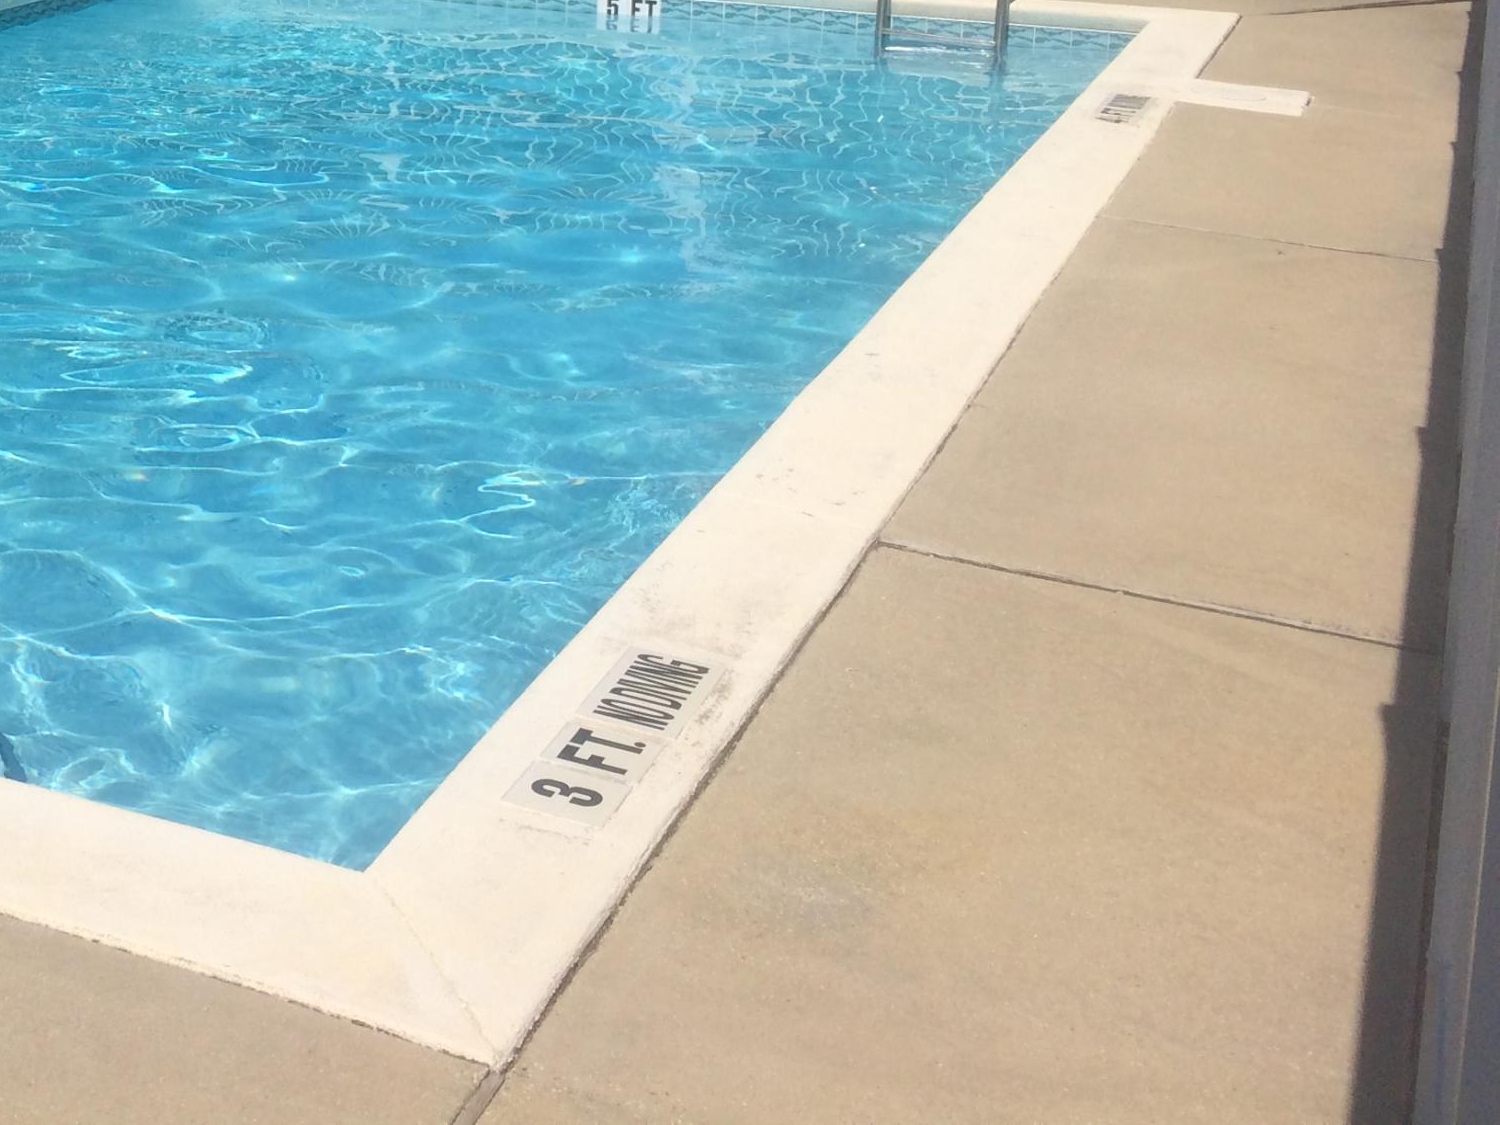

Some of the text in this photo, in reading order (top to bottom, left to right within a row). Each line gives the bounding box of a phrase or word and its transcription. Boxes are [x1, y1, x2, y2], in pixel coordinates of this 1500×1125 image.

[630, 0, 657, 25] FT
[609, 653, 710, 711] DIVING
[592, 698, 675, 731] NO
[531, 778, 603, 807] 3
